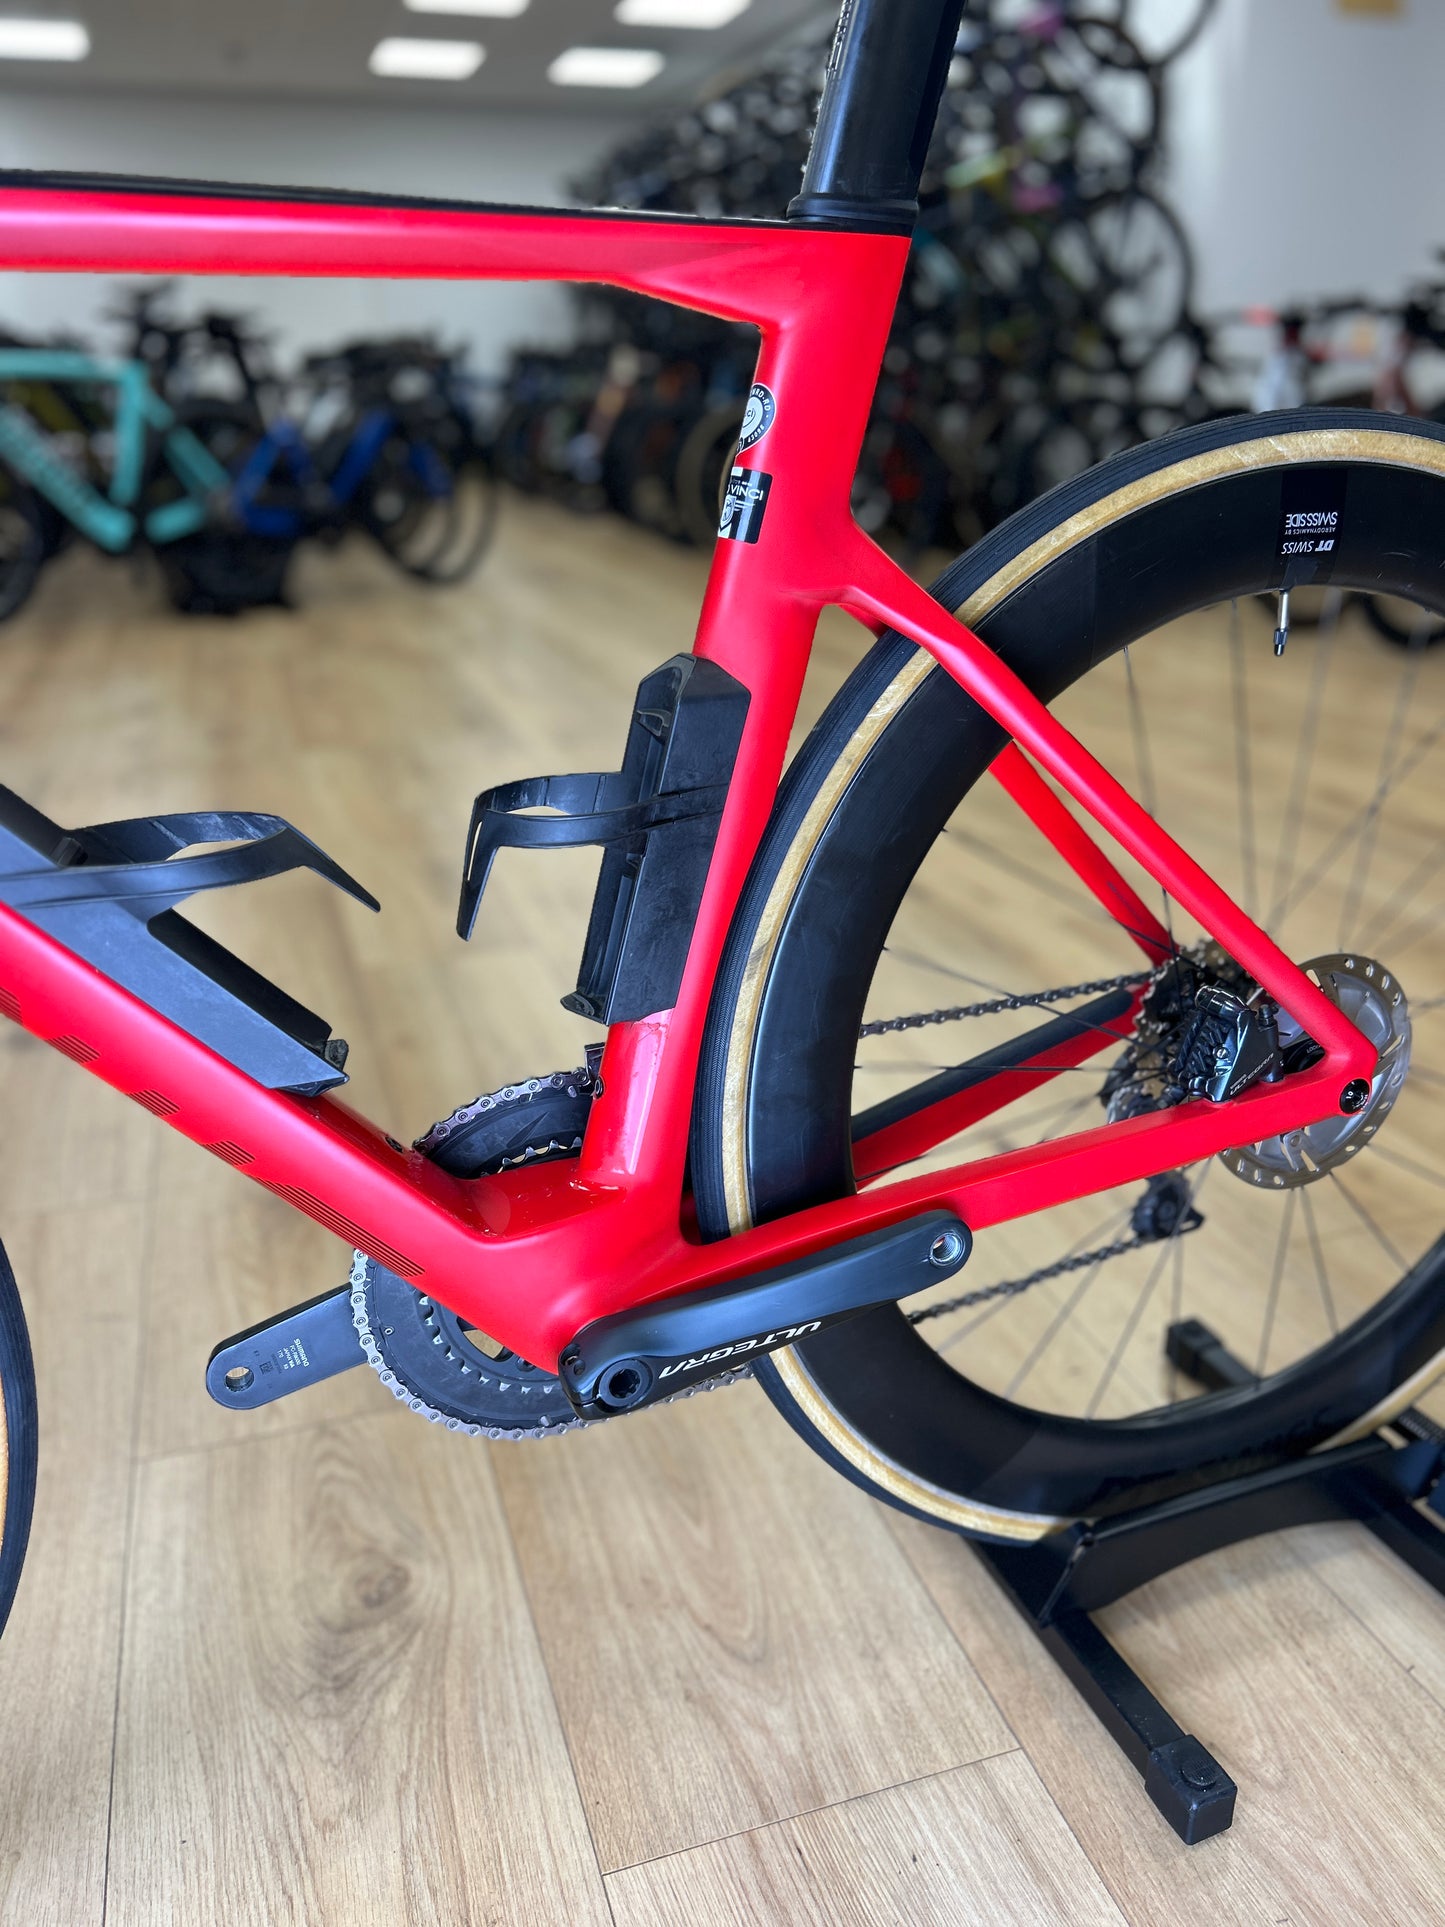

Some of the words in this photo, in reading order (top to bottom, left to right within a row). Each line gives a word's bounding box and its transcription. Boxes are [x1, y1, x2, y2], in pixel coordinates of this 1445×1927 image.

[731, 484, 763, 501] VINCI
[1281, 541, 1314, 554] SWISS
[1315, 540, 1334, 551] DT
[1230, 1053, 1274, 1096] ULTEGRA
[294, 1338, 309, 1367] SHIMANO
[658, 1321, 822, 1379] ULTEGRA
